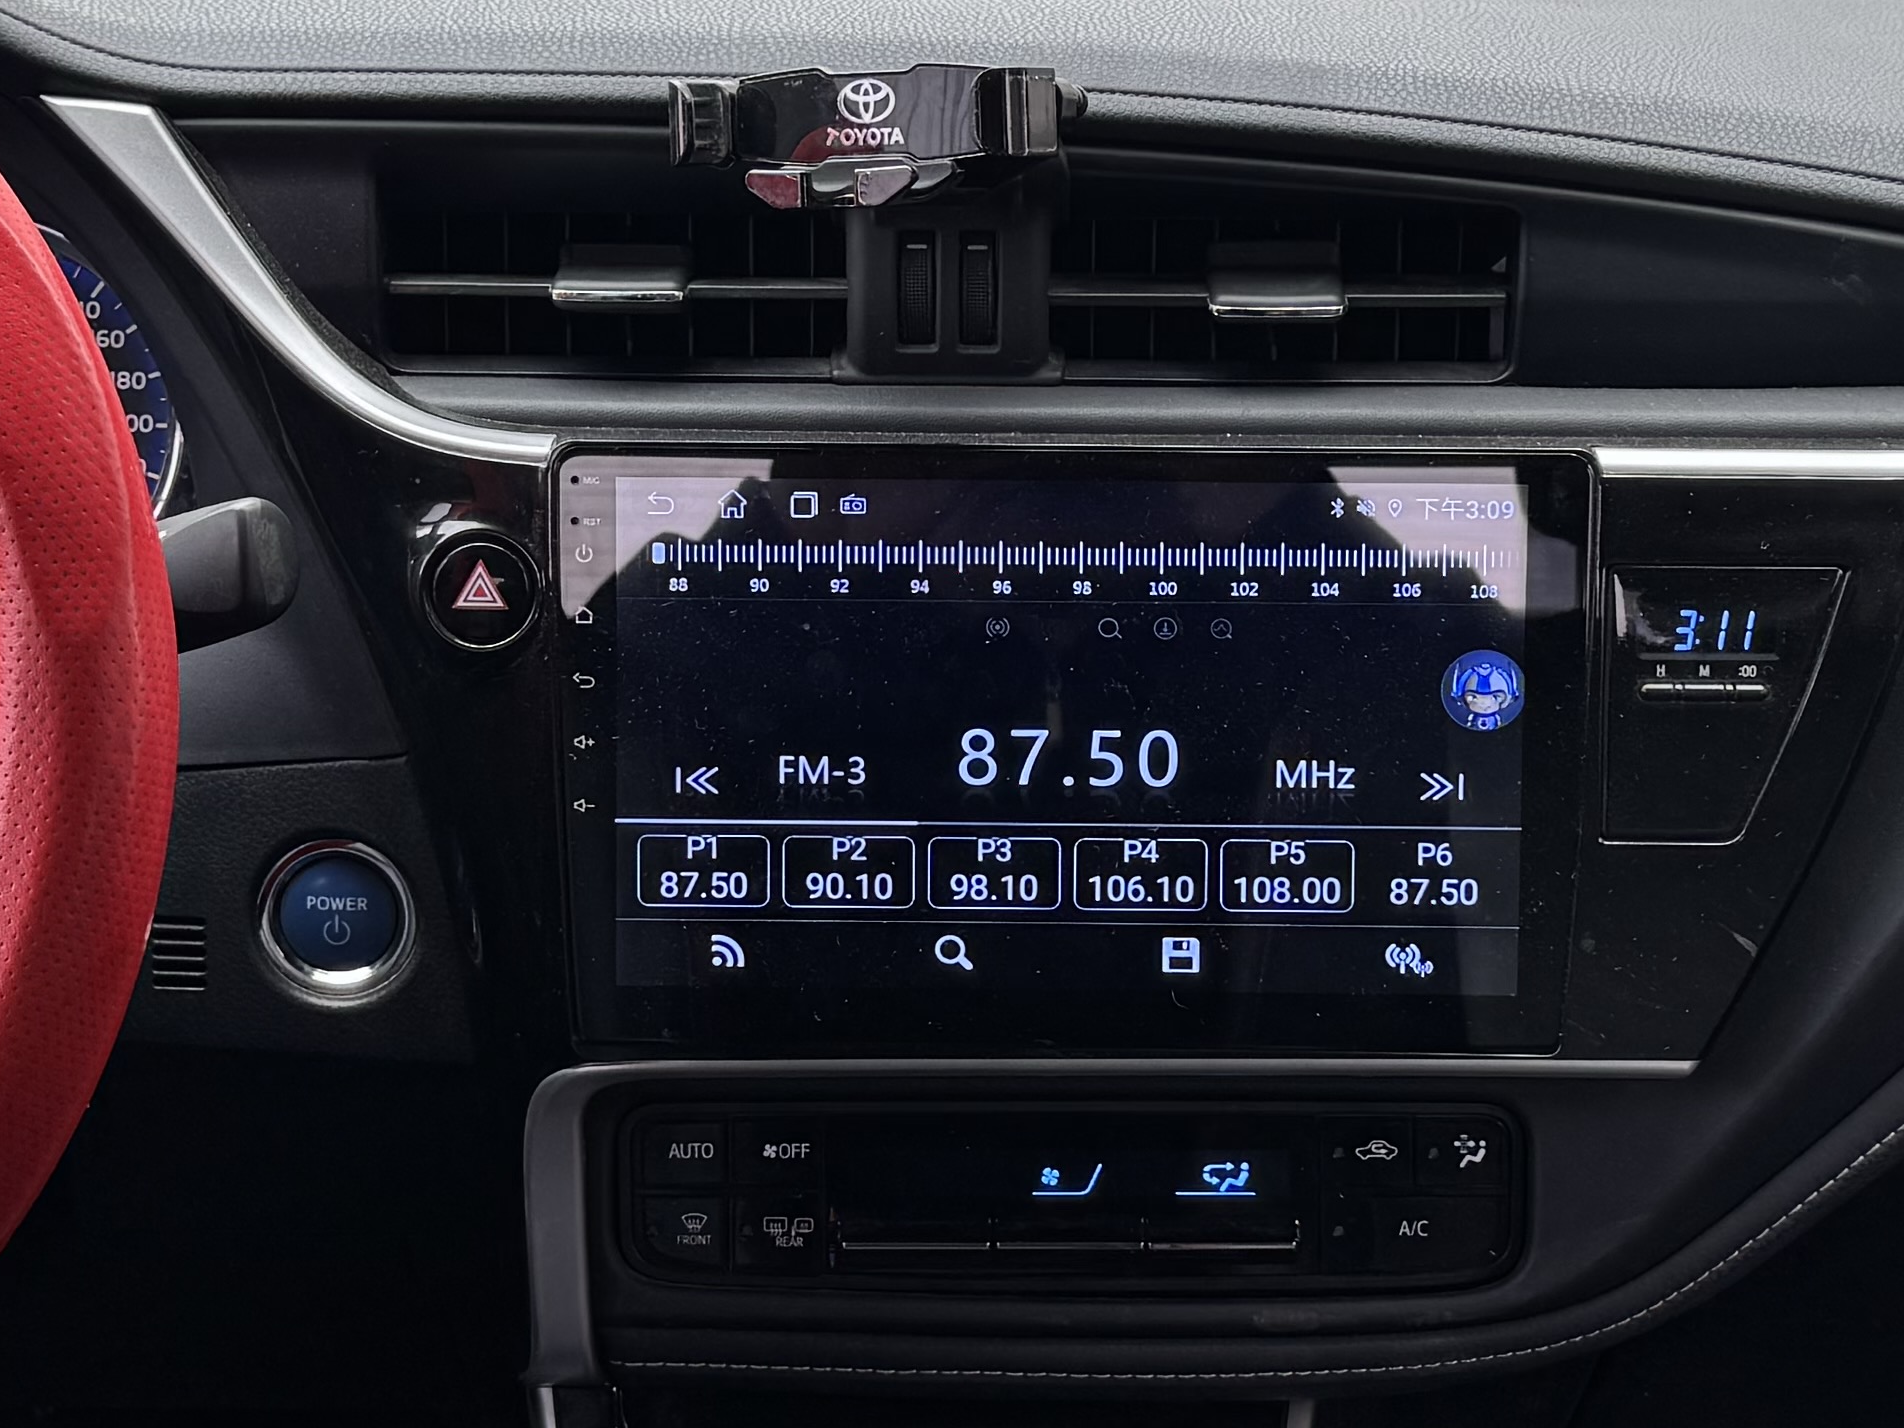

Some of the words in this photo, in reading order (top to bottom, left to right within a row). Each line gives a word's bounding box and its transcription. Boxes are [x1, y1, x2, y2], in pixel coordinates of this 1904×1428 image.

[825, 126, 905, 147] TOYOTA
[1416, 496, 1515, 521] 下午3:09
[669, 578, 688, 593] 88
[749, 578, 770, 593] 90
[830, 579, 850, 594] 92
[910, 579, 930, 594] 94
[992, 580, 1012, 595] 96
[1072, 581, 1093, 595] 98
[1149, 581, 1178, 596] 100
[1230, 582, 1259, 597] 102
[1311, 582, 1340, 597] 104
[1392, 583, 1422, 598] 106
[1470, 584, 1498, 600] 108
[1673, 609, 1756, 652] 3:11
[1656, 664, 1666, 677] H
[1698, 664, 1710, 677] M
[778, 755, 866, 785] FM-3
[957, 728, 1179, 788] 87.50
[1275, 759, 1356, 790] MHz
[686, 835, 719, 860] P1
[831, 836, 867, 861] P2
[977, 838, 1012, 863] P3
[1122, 839, 1160, 864] P4
[1269, 841, 1306, 865] P5
[1416, 842, 1453, 867] P6
[660, 871, 748, 899] 87.50
[805, 873, 893, 900] 90.10
[950, 874, 1038, 901] 98.10
[1088, 875, 1194, 903] 106.10
[1234, 876, 1341, 905] 108.00
[1389, 878, 1479, 907] 87.50
[306, 895, 368, 912] POWER
[669, 1143, 714, 1159] AUTO
[779, 1143, 811, 1159] OFF
[676, 1234, 712, 1245] FRONT
[1398, 1220, 1429, 1237] A/C
[776, 1236, 804, 1248] REAR
